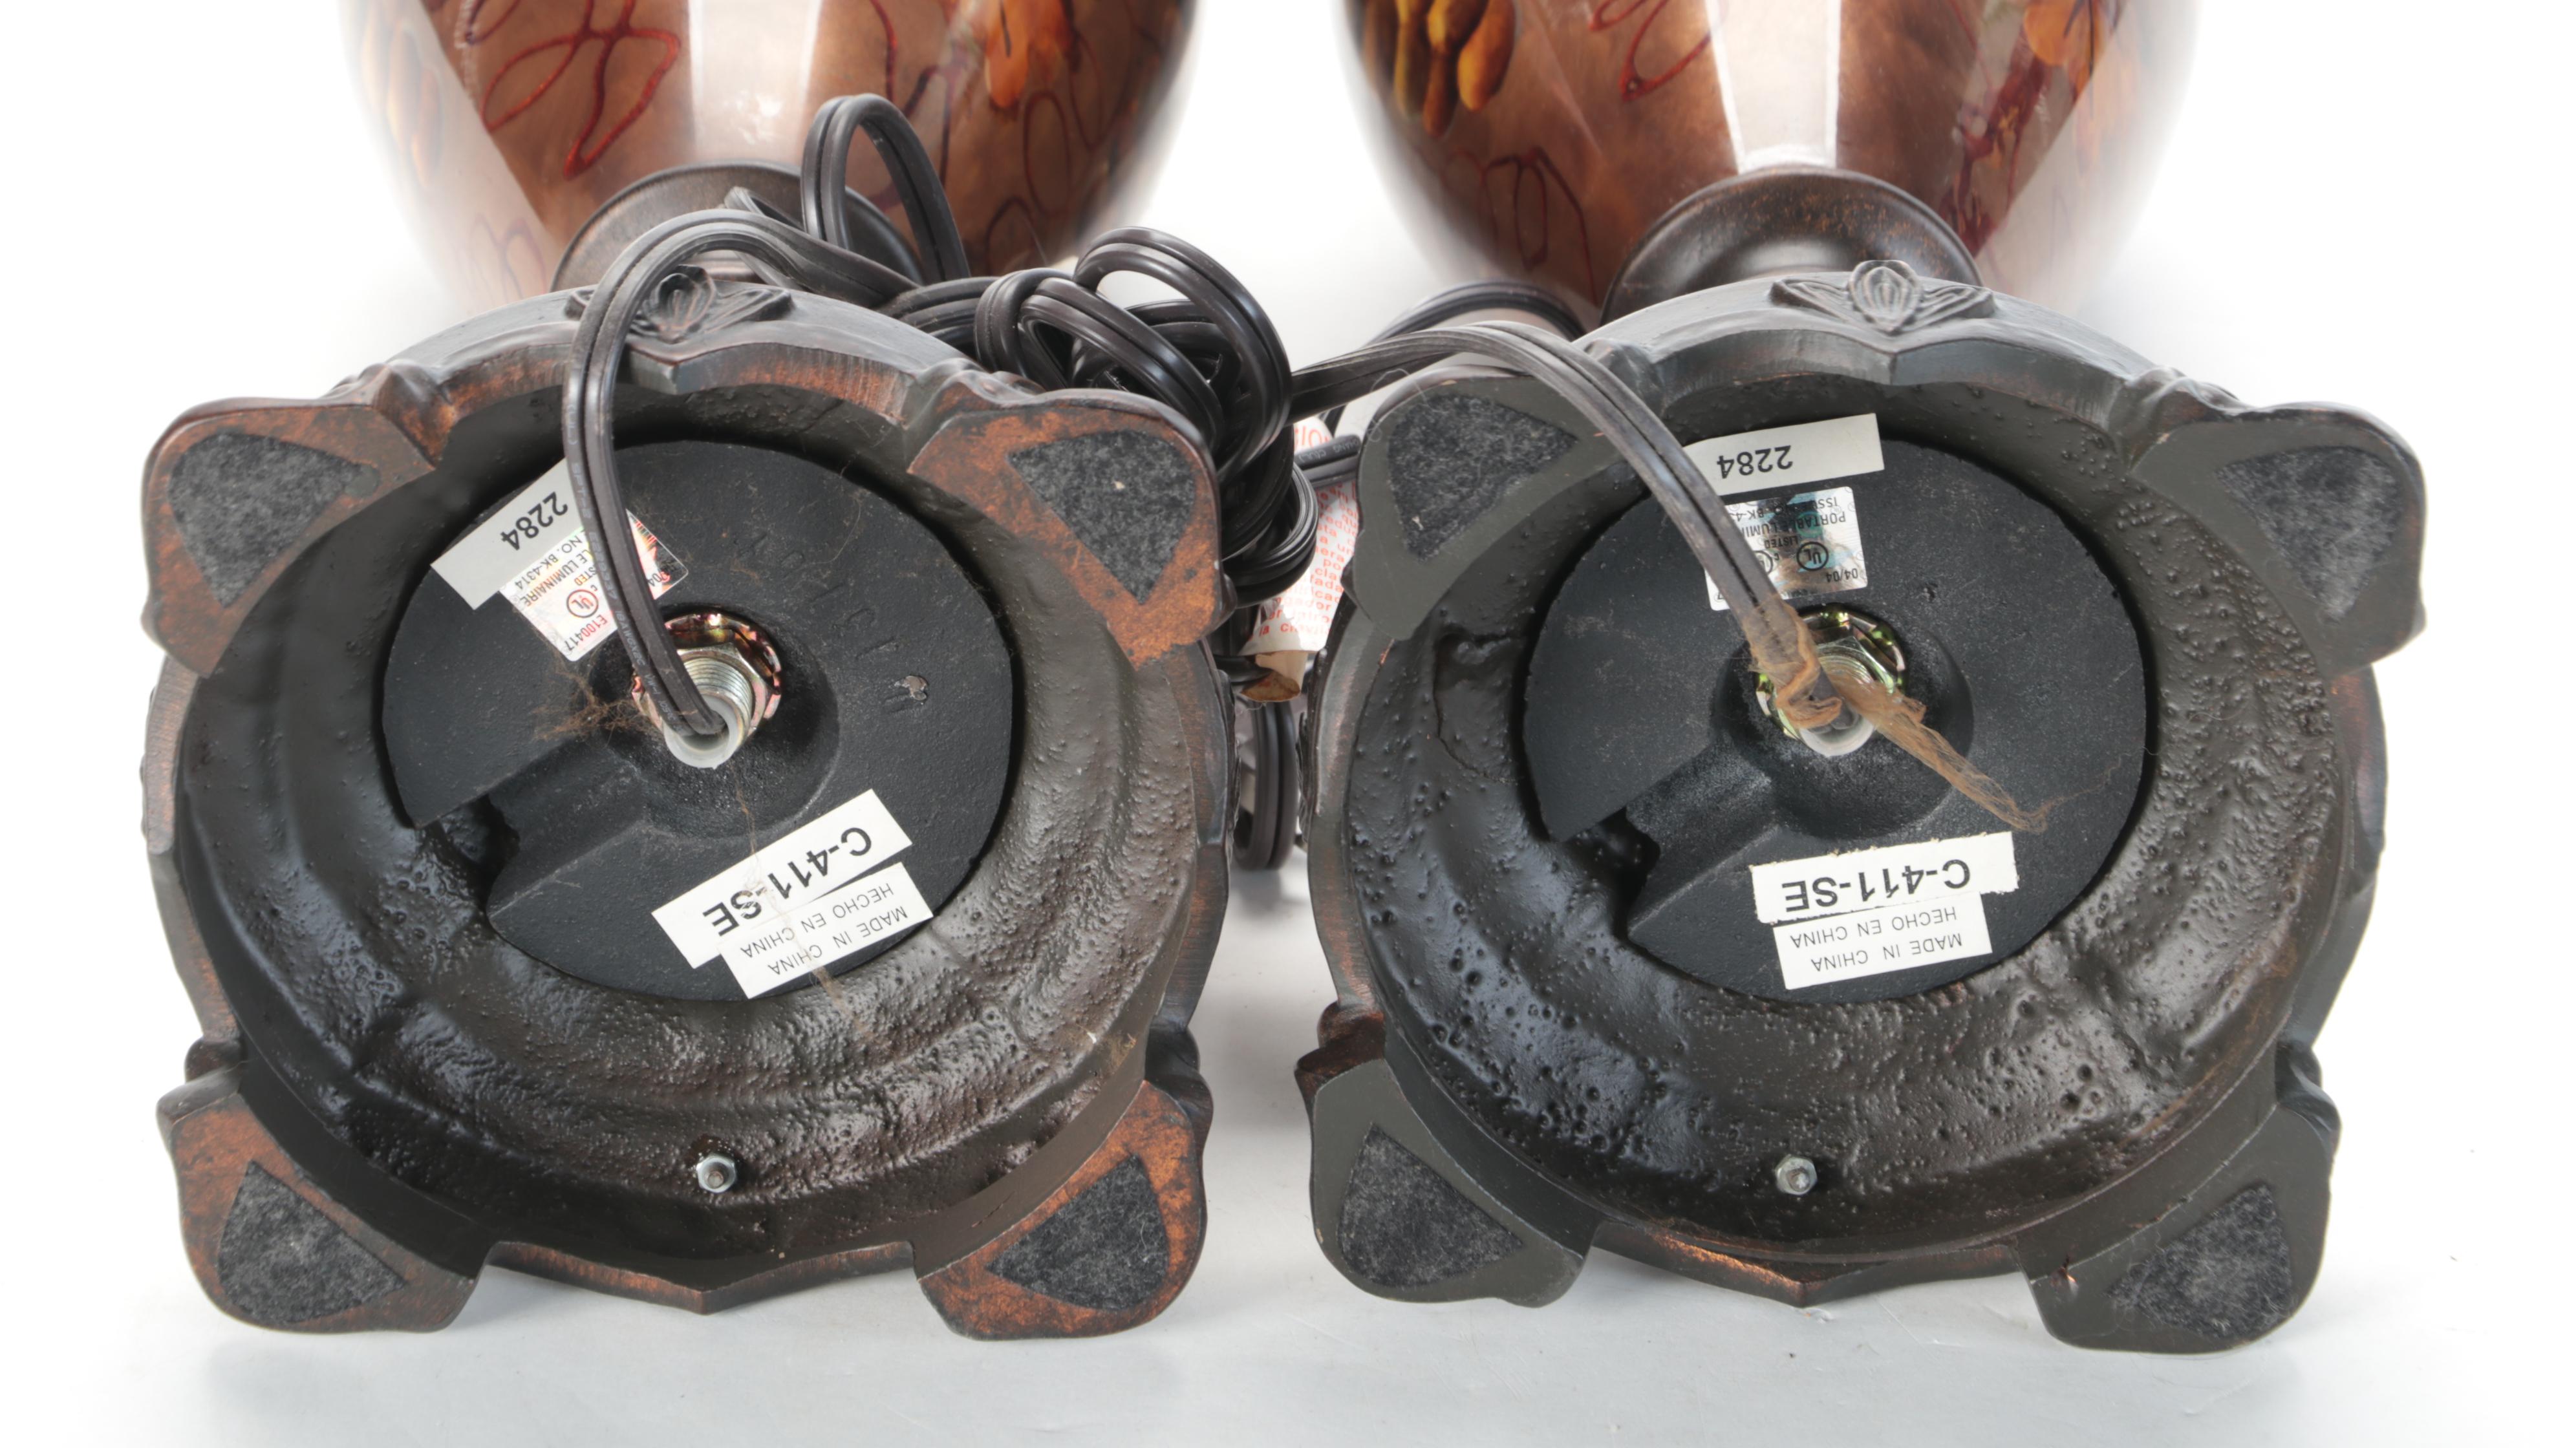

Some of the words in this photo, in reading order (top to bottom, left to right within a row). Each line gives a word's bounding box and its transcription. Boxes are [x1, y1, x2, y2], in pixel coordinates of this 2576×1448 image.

[1717, 445, 1793, 479] 2284
[500, 492, 568, 551] 2284
[557, 535, 583, 553] NO.
[1763, 535, 1799, 549] LISTED
[515, 553, 559, 590] BK-4314
[519, 559, 579, 607] LUMINAIRE
[574, 566, 597, 586] STED
[1825, 568, 1859, 583] 04/04
[564, 613, 608, 652] E100417
[702, 827, 872, 937] C-411-SE
[1781, 858, 1970, 912] C-411-SE
[832, 882, 894, 920] HECHO
[801, 912, 827, 933] EN
[856, 905, 908, 939] MADE
[1856, 919, 1882, 937] EN
[1891, 906, 1957, 931] HECHO
[740, 926, 795, 959] CHINA
[832, 930, 853, 952] IN
[1790, 925, 1848, 948] CHINA
[1911, 932, 1962, 955] MADE
[767, 944, 822, 976] CHINA
[1810, 950, 1869, 972] CHINA
[1883, 943, 1901, 961] IN
